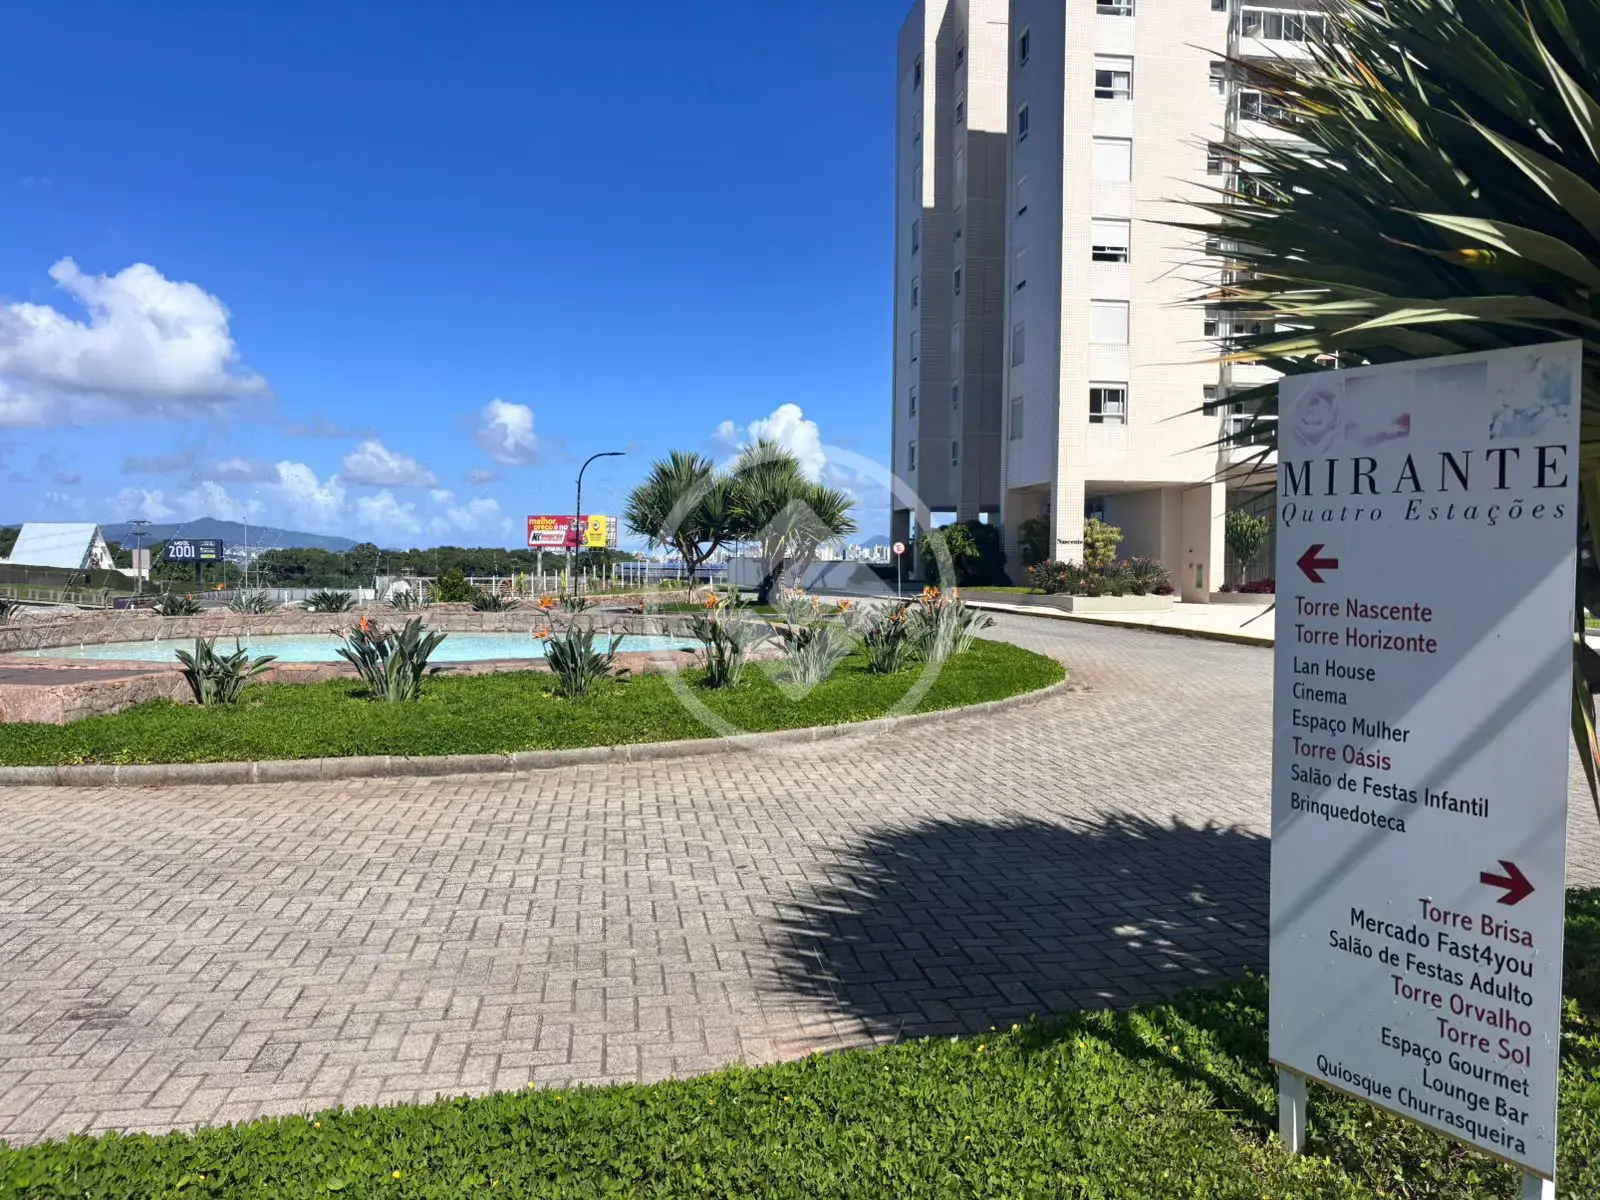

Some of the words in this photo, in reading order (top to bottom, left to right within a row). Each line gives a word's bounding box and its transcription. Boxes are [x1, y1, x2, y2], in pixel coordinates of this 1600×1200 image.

[1282, 445, 1568, 497] MIRANTE
[1282, 501, 1382, 528] Quatro
[1405, 499, 1566, 526] Estações
[169, 546, 195, 557] 2001
[1295, 596, 1340, 617] Torre
[1346, 599, 1432, 622] Nascente
[1295, 624, 1339, 646] Torre
[1346, 627, 1437, 653] Horizonte
[1293, 657, 1319, 675] Lan
[1325, 659, 1376, 681] House
[1293, 682, 1347, 705] Cinema
[1293, 709, 1346, 736] Espaço
[1352, 717, 1410, 743] Mulher
[1292, 736, 1336, 760] Torre
[1343, 744, 1391, 771] Oásis
[1291, 764, 1332, 787] Salão
[1337, 773, 1357, 792] de
[1364, 777, 1417, 804] Festas
[1425, 788, 1489, 818] Infantil
[1291, 792, 1406, 833] Brinquedoteca
[1350, 907, 1429, 948] Mercado
[1438, 932, 1533, 977] Fast4you
[1419, 897, 1472, 930] Torre
[1482, 913, 1534, 948] Brisa
[1329, 930, 1372, 958] Salão
[1379, 947, 1400, 967] de
[1406, 955, 1463, 986] Festas
[1470, 972, 1533, 1007] Adulto
[1391, 974, 1442, 1009] Torre
[1450, 996, 1532, 1037] Orvalho
[1381, 1026, 1442, 1066] Espaço
[1449, 1052, 1529, 1097] Gourmet
[1436, 1017, 1490, 1053] Torre
[1497, 1039, 1531, 1067] Sol
[1316, 1054, 1392, 1099] Quiosque
[1398, 1086, 1526, 1155] Churrasqueira
[1423, 1068, 1490, 1112] Lounge
[1495, 1098, 1529, 1126] Bar
